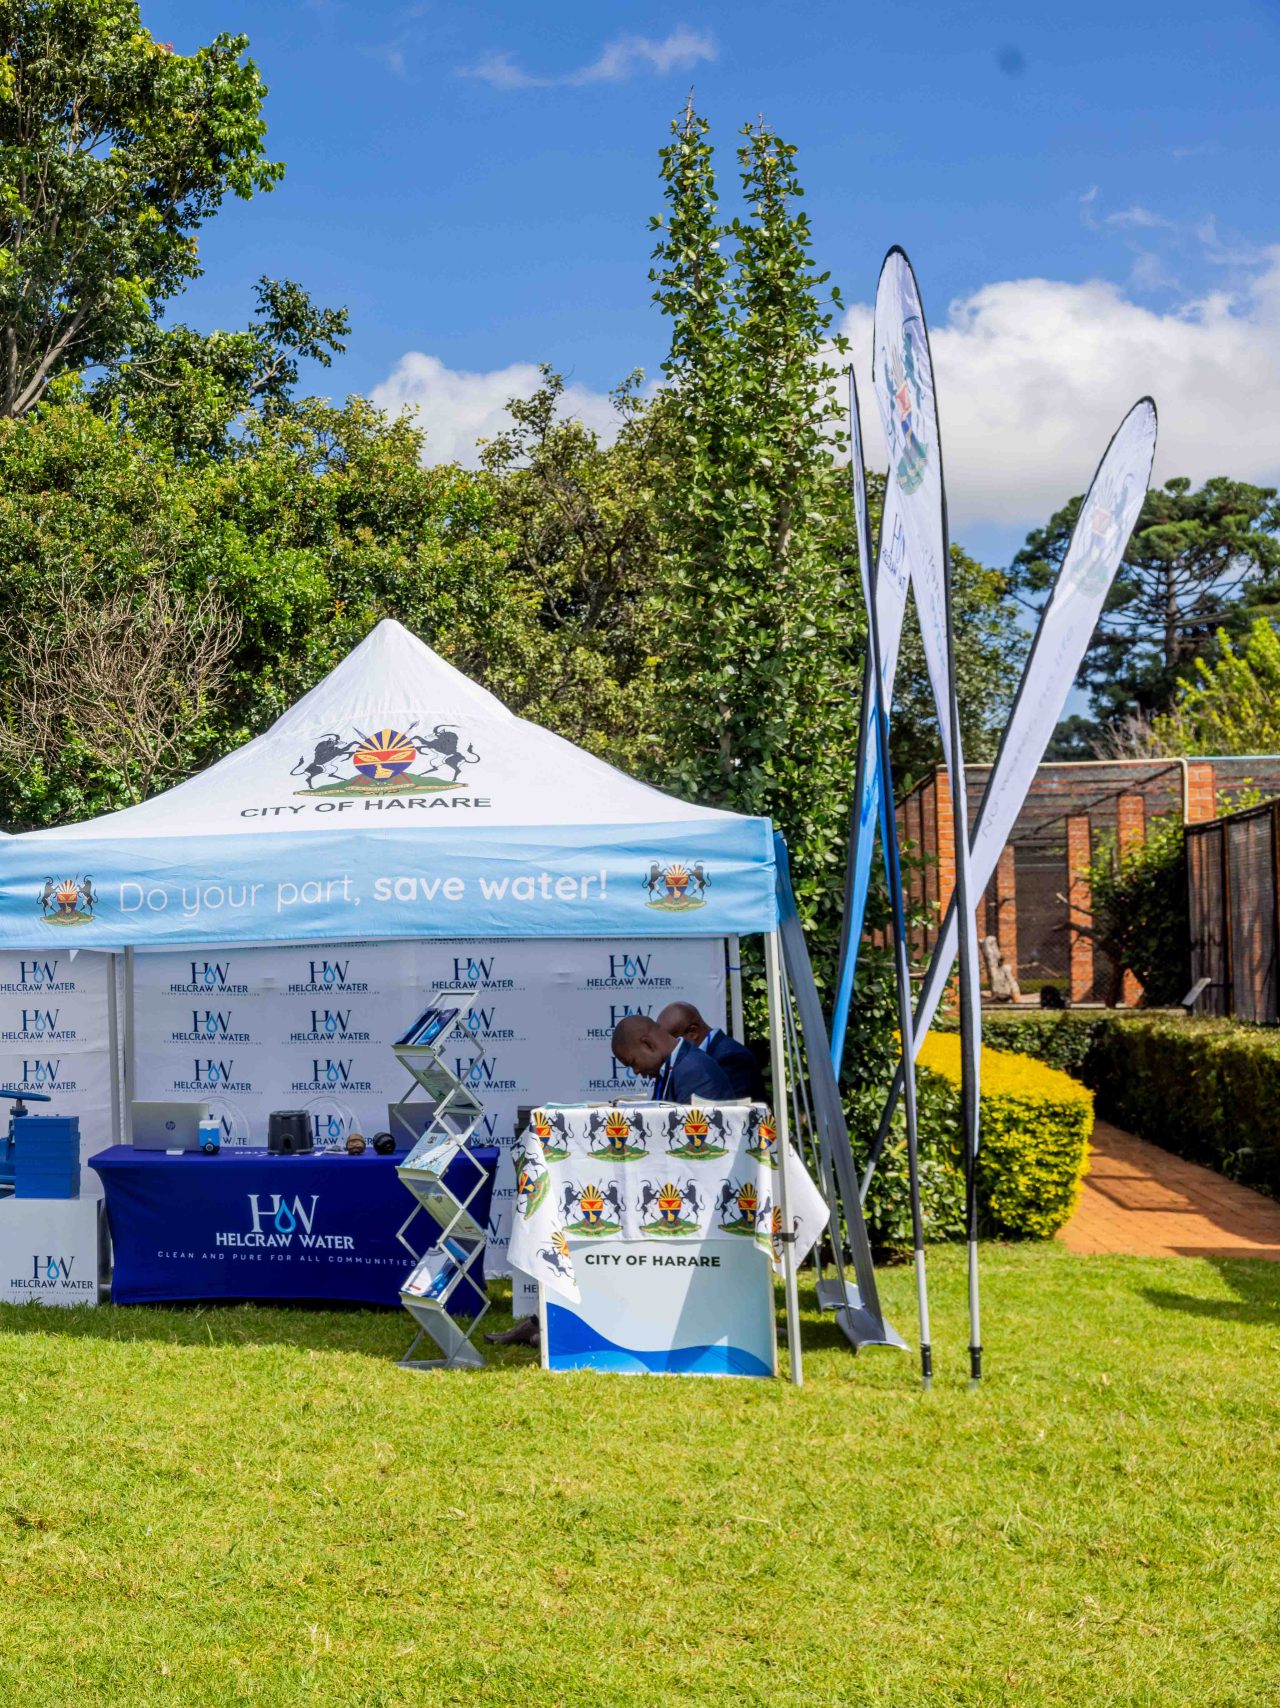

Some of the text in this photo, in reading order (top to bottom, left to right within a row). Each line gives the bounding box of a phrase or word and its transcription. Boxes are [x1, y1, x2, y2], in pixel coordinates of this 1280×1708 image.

[240, 797, 492, 818] CITY OF HARARE
[120, 869, 608, 918] Do your part, save water!
[0, 982, 75, 992] HELCRAW WATER
[432, 980, 514, 990] HELCRAW WATER
[587, 977, 672, 987] HELCRAW WATER
[170, 984, 248, 993] HELCRAW WATER
[288, 983, 368, 992] HELCRAW WATER
[1, 1031, 76, 1040] HELCRAW WATER
[172, 1032, 250, 1042] HELCRAW WATER
[290, 1032, 370, 1041] HELCRAW WATER
[483, 1030, 514, 1038] WATER
[1, 1082, 76, 1091] HELCRAW WATER
[173, 1081, 252, 1091] HELCRAW WATER
[291, 1081, 371, 1091] HELCRAW WATER
[485, 1080, 516, 1089] WATER
[589, 1080, 636, 1088] HELCRAW
[216, 1232, 355, 1250] HELCRAW WATER
[202, 1252, 225, 1260] AND
[233, 1253, 263, 1261] PURE
[270, 1254, 292, 1262] FOR
[299, 1254, 320, 1262] ALL
[328, 1255, 417, 1267] COMMUNITIES
[585, 1254, 721, 1267] CITY OF HARARE
[10, 1279, 93, 1289] HELCRAW WATER
